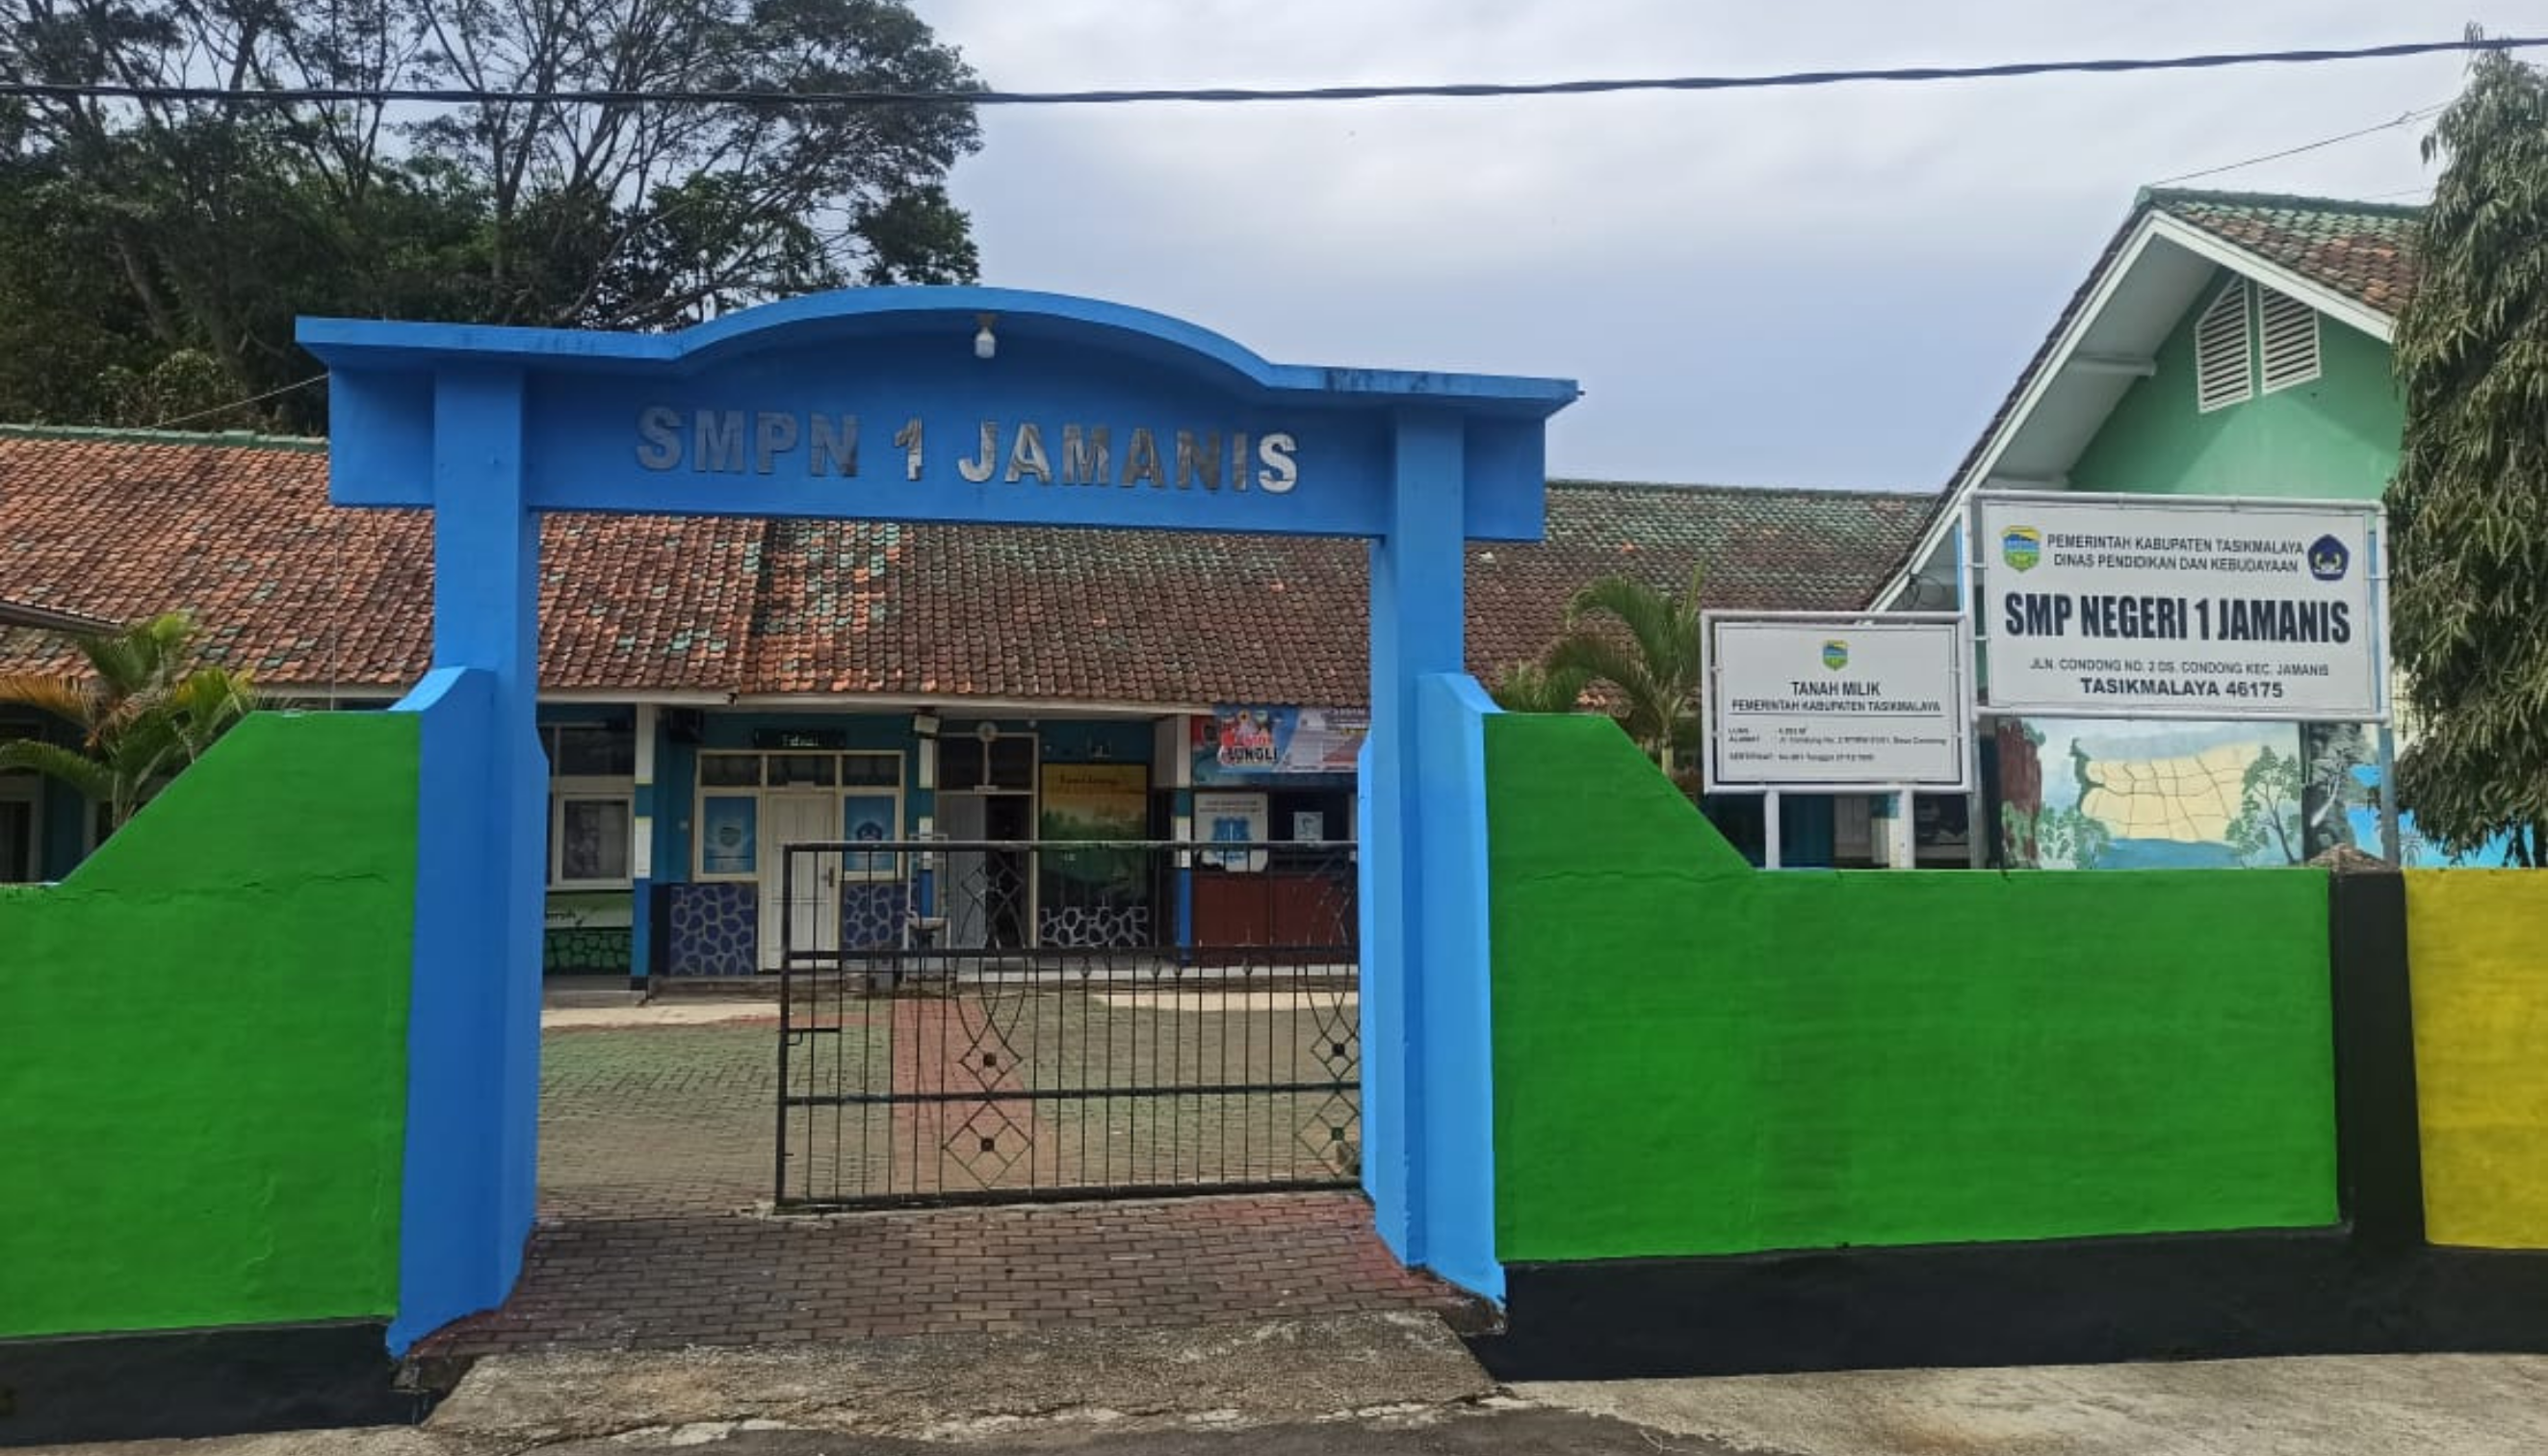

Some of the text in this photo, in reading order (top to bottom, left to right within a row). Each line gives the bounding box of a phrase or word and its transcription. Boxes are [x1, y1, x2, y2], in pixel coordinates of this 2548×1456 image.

[637, 405, 1299, 493] SMPN 1 JAMANIS
[2047, 533, 2304, 555] PEMERINTAH KABUPATEN TASIKMALAYA
[2054, 553, 2299, 573] DINAS PENDIDIKAN DAN KEBUDAYAAN
[2005, 592, 2351, 643] SMP NEGERI 1 JAMANIS
[2059, 659, 2121, 672] CONDONG
[2181, 662, 2243, 674] CONDONG
[2277, 663, 2328, 676] JAMANIS
[1792, 681, 1881, 696] TANAH MILIK
[2080, 677, 2283, 698] TASIKMALAYA 46175
[1732, 699, 1940, 712] PEMERINTAH KABUPATEN TASIKMALAYA
